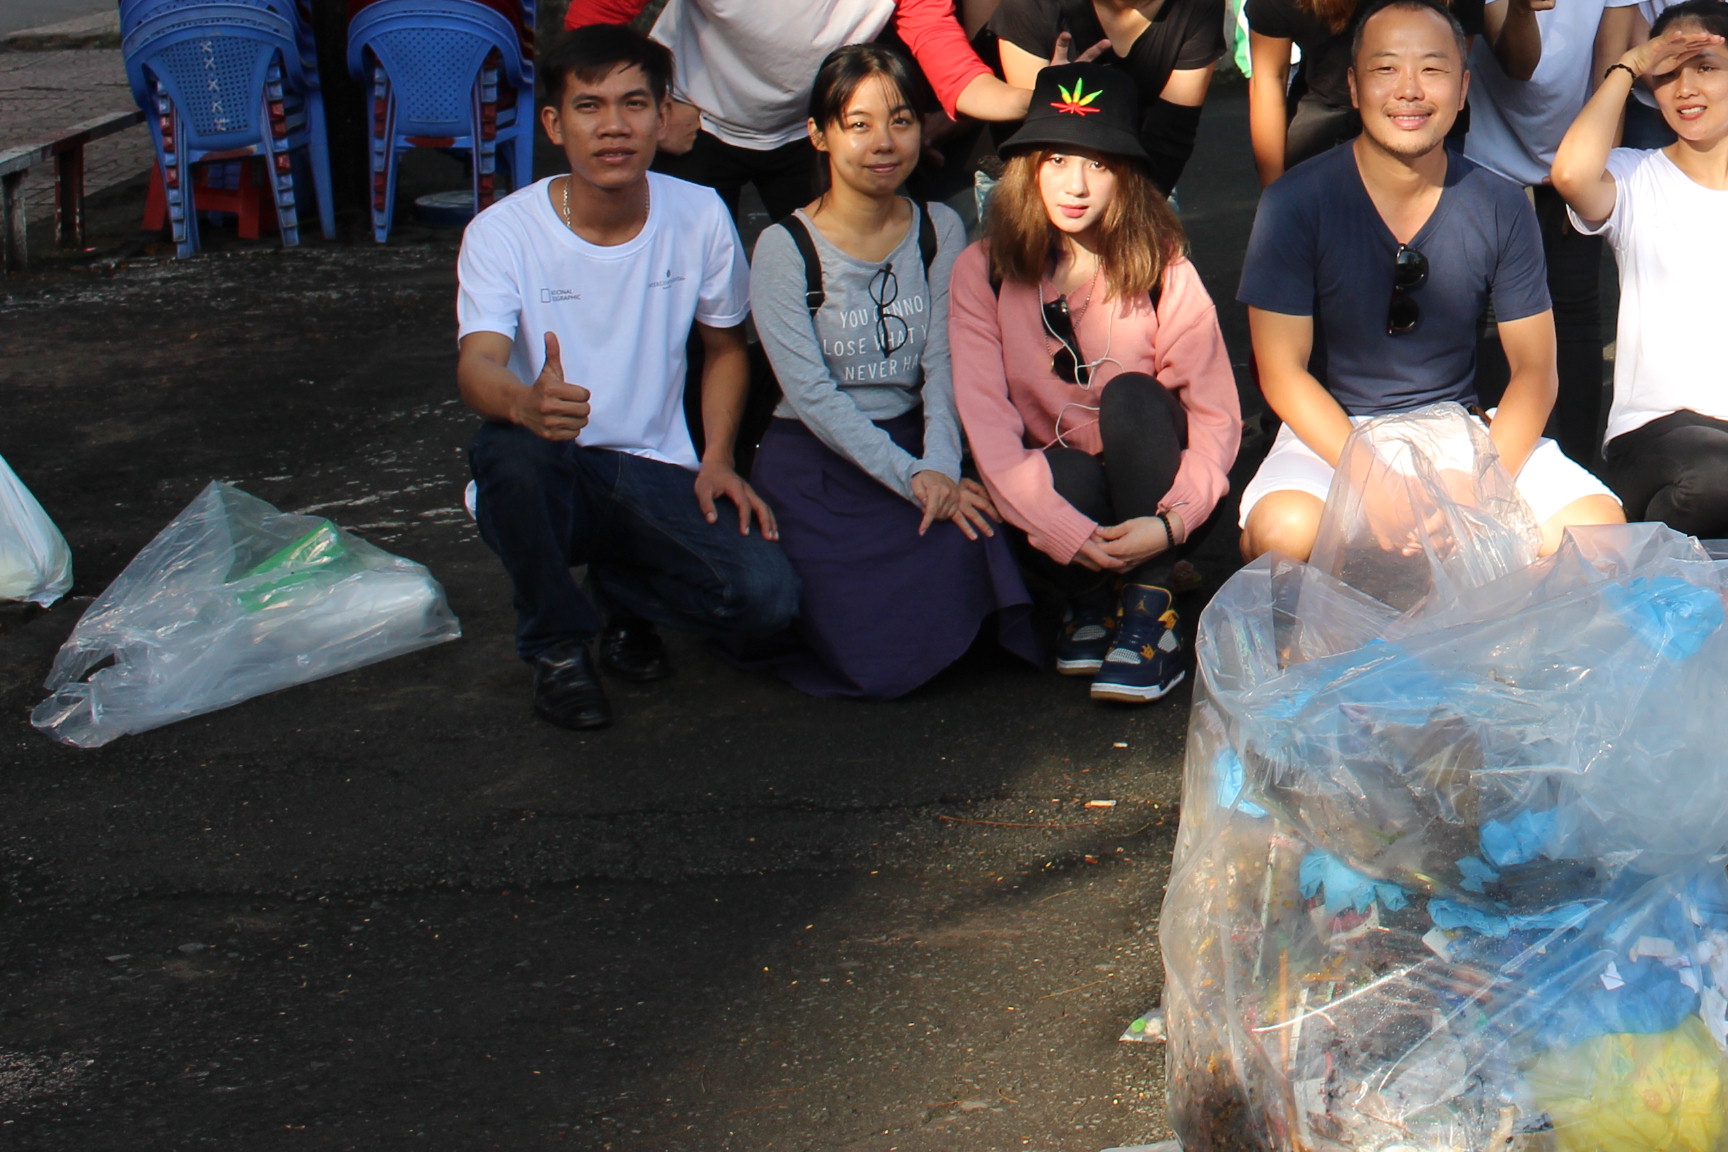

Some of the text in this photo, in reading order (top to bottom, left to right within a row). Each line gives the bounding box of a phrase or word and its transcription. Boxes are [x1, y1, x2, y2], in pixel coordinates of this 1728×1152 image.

[839, 309, 868, 329] YOU
[823, 337, 867, 357] LOSE
[873, 327, 915, 352] WHAT
[845, 358, 897, 382] NEVER
